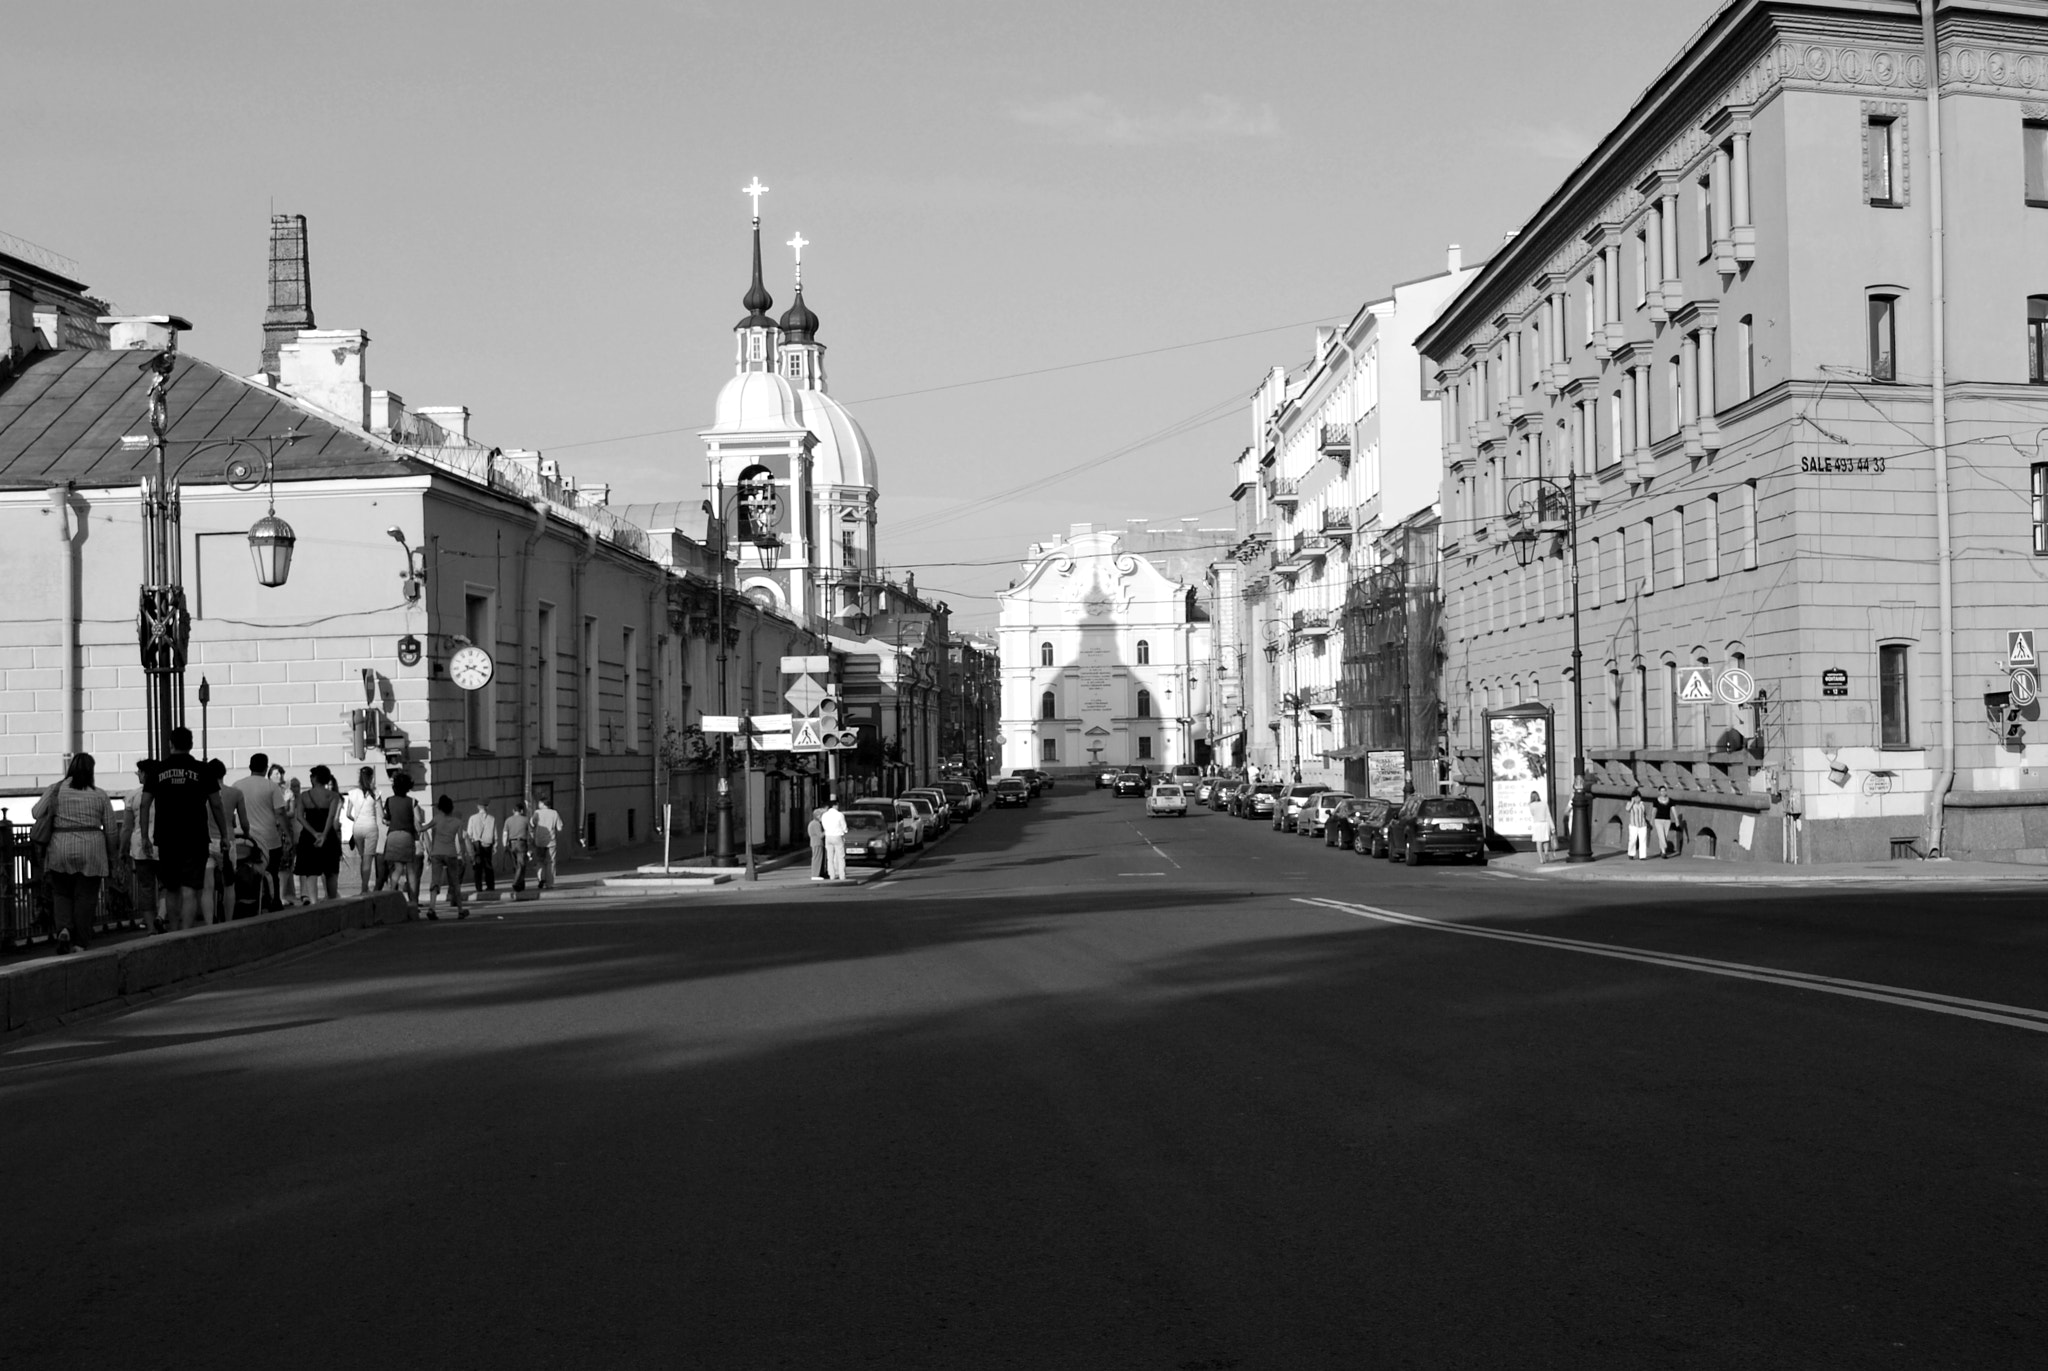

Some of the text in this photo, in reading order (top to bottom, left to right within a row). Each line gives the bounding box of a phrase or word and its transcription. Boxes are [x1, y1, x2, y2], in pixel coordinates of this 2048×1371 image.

[1801, 456, 1886, 472] SALE 493 44 33
